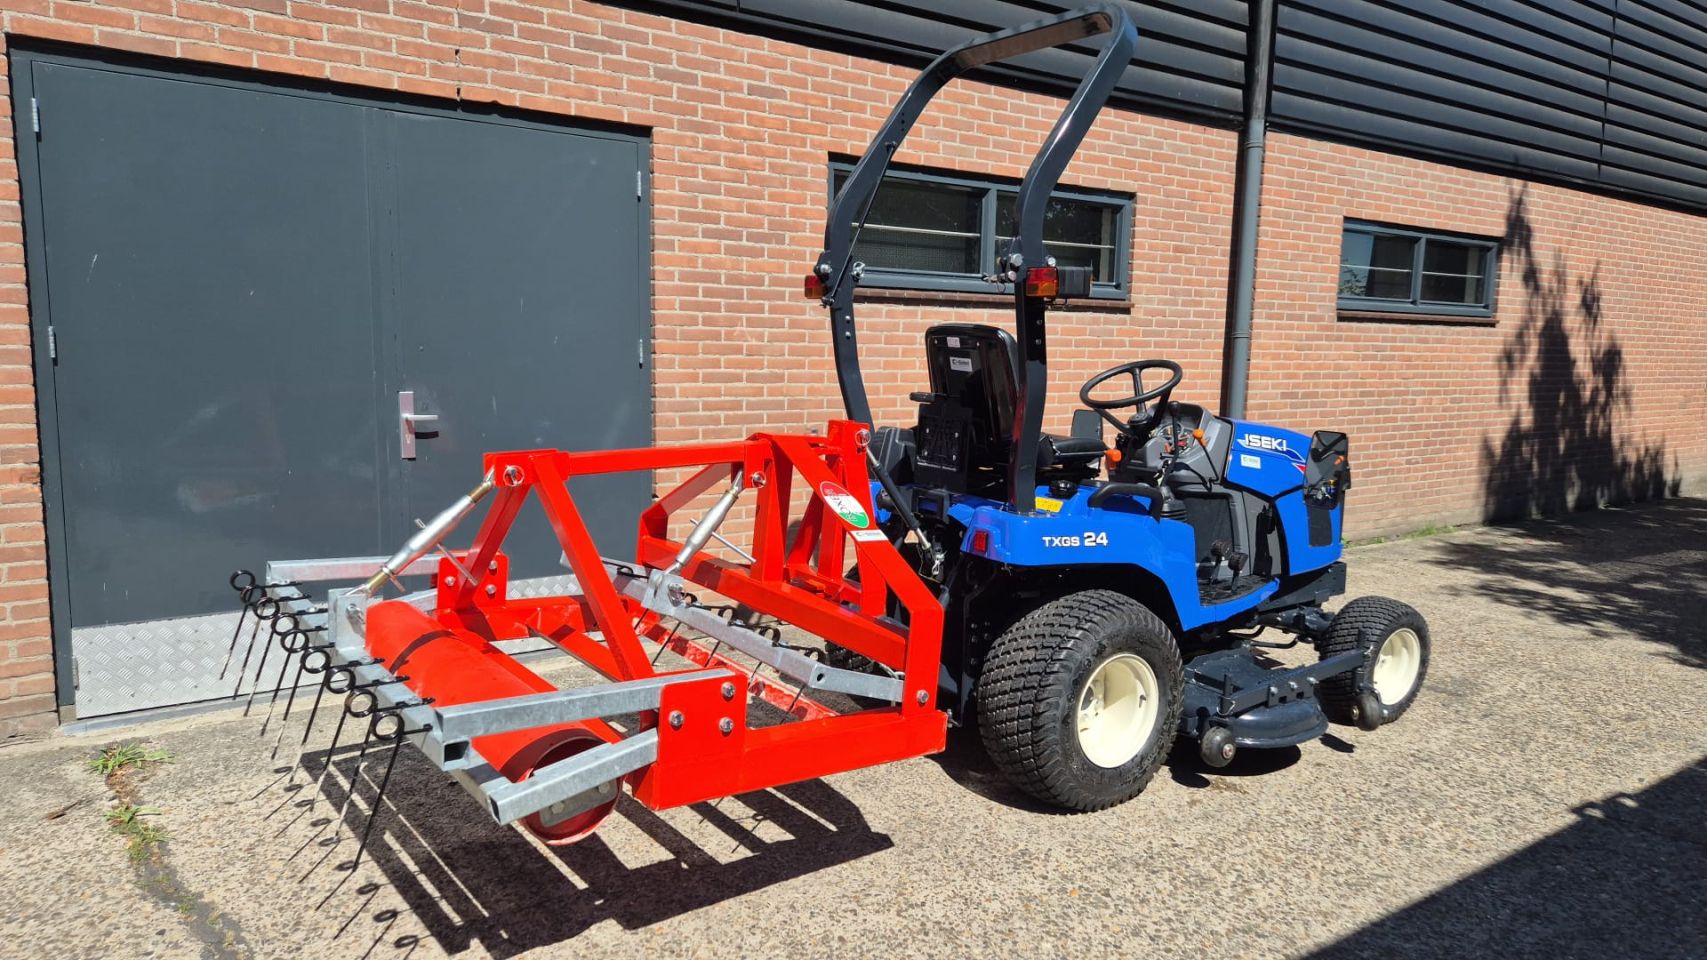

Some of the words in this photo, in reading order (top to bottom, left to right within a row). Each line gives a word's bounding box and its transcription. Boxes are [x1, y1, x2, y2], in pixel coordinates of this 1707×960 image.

[1244, 433, 1287, 451] ISEKI
[1042, 536, 1080, 547] TXGS
[1083, 531, 1109, 547] 24
